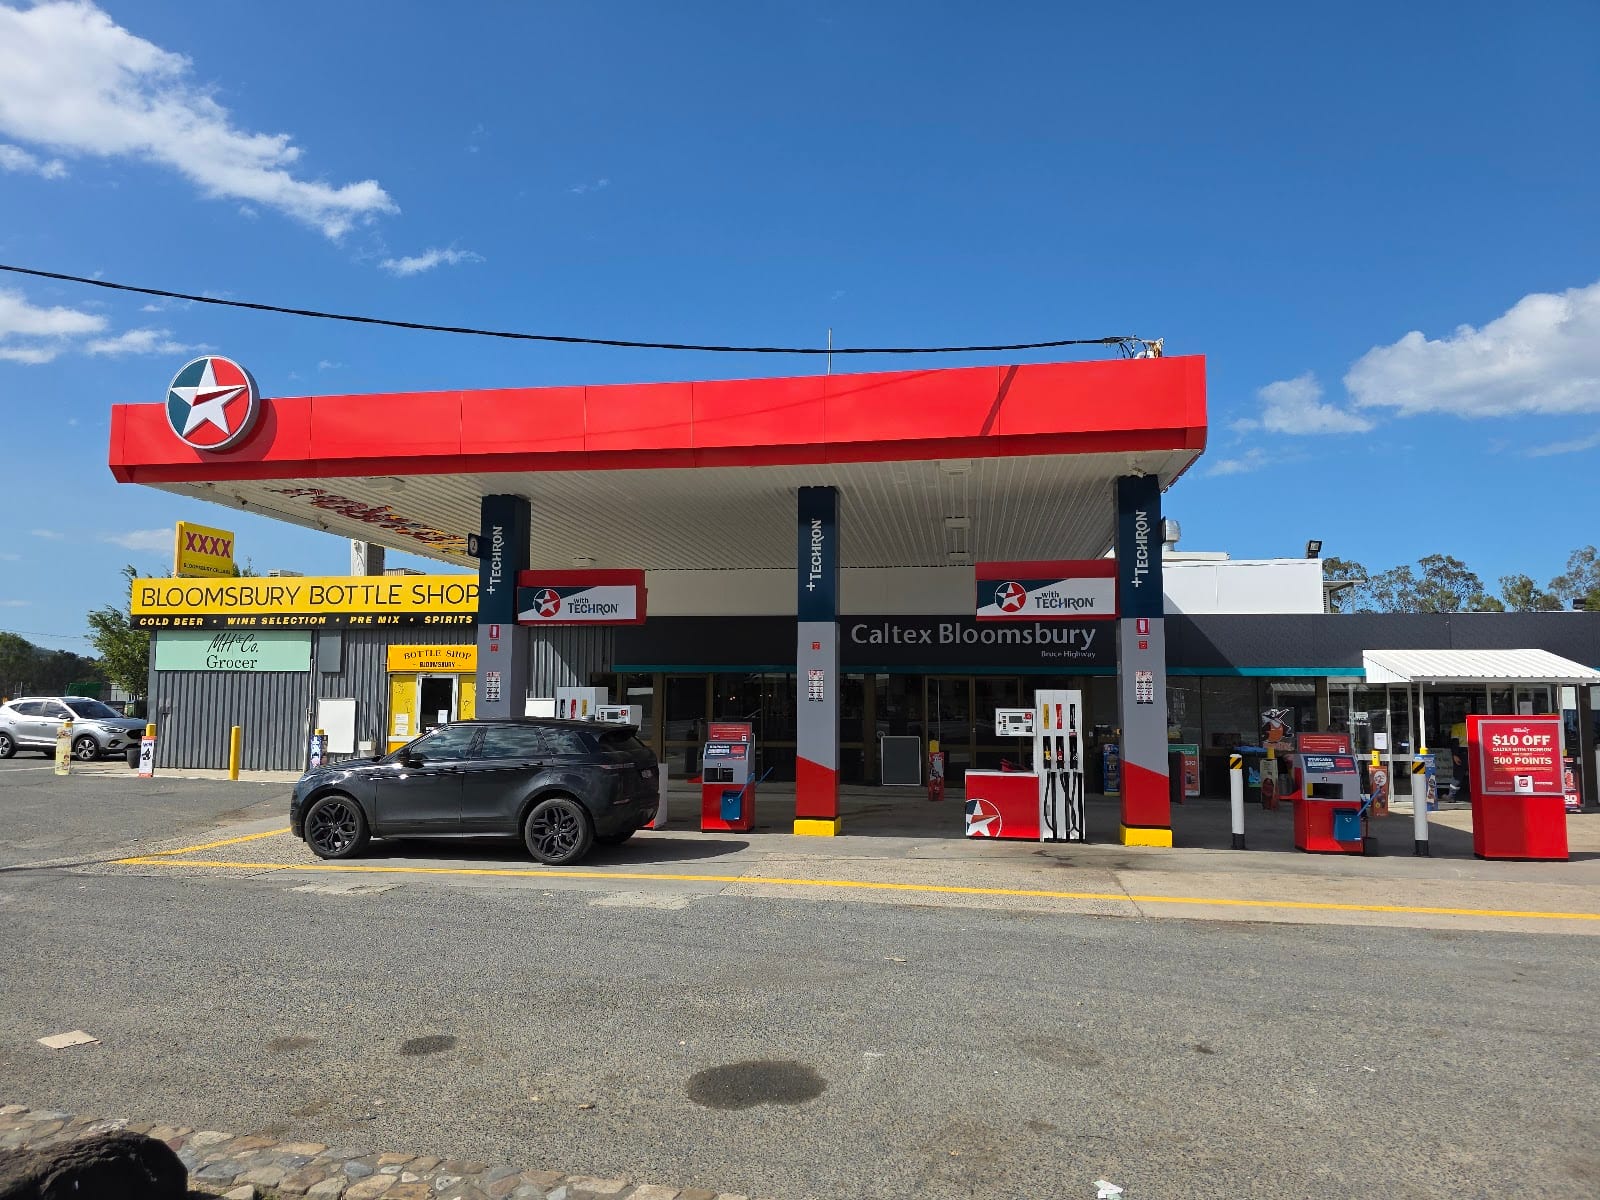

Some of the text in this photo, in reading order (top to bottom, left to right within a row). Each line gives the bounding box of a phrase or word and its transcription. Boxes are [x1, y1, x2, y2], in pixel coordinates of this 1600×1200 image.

[185, 531, 231, 559] XXXX
[141, 583, 479, 607] BLOOMSBURY BOTTLE SHOP
[1041, 591, 1060, 599] with
[567, 602, 619, 615] TECHRON
[1034, 597, 1096, 611] TECHRON
[139, 615, 473, 626] COLD BEER WINE SELECTION PRE MIX SPIRITS
[850, 622, 1096, 650] Caltex Bloomsbury
[404, 649, 472, 660] BOTTLE SHOP
[1063, 650, 1096, 659] Highway
[206, 654, 258, 669] Grocer
[1492, 733, 1551, 746] $10 OFF
[1493, 756, 1552, 765] 500 POINTS
